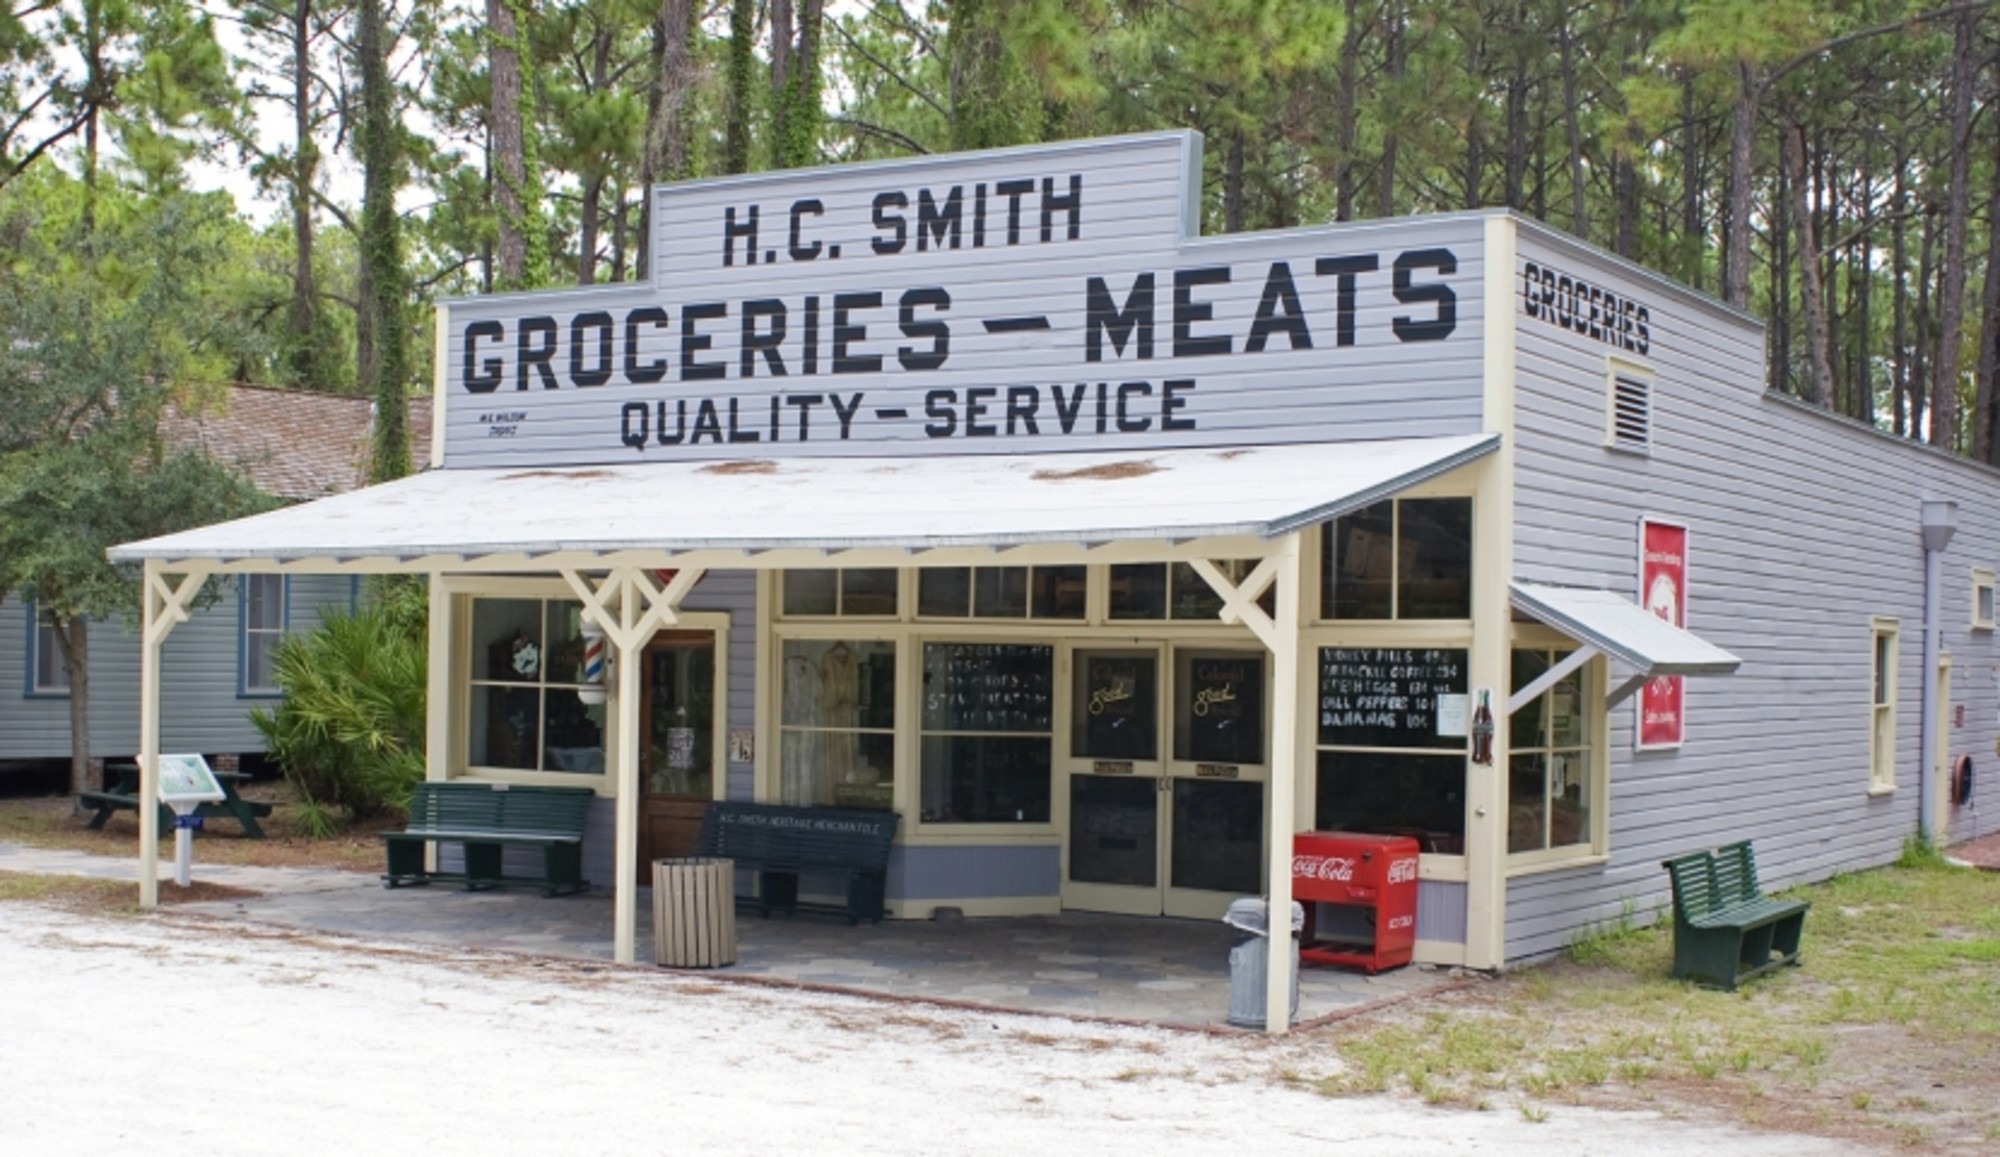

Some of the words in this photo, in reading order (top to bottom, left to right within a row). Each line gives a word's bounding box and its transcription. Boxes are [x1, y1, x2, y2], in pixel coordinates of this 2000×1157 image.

[722, 199, 841, 267] H.C.
[870, 174, 1083, 256] SMITH
[462, 286, 952, 394] GROCERIES
[1085, 247, 1458, 363] MEATS
[1524, 261, 1650, 357] GROCERIES
[620, 392, 865, 451] QUALITY
[923, 378, 1197, 439] SERVICE
[1322, 710, 1397, 728] BANANAS
